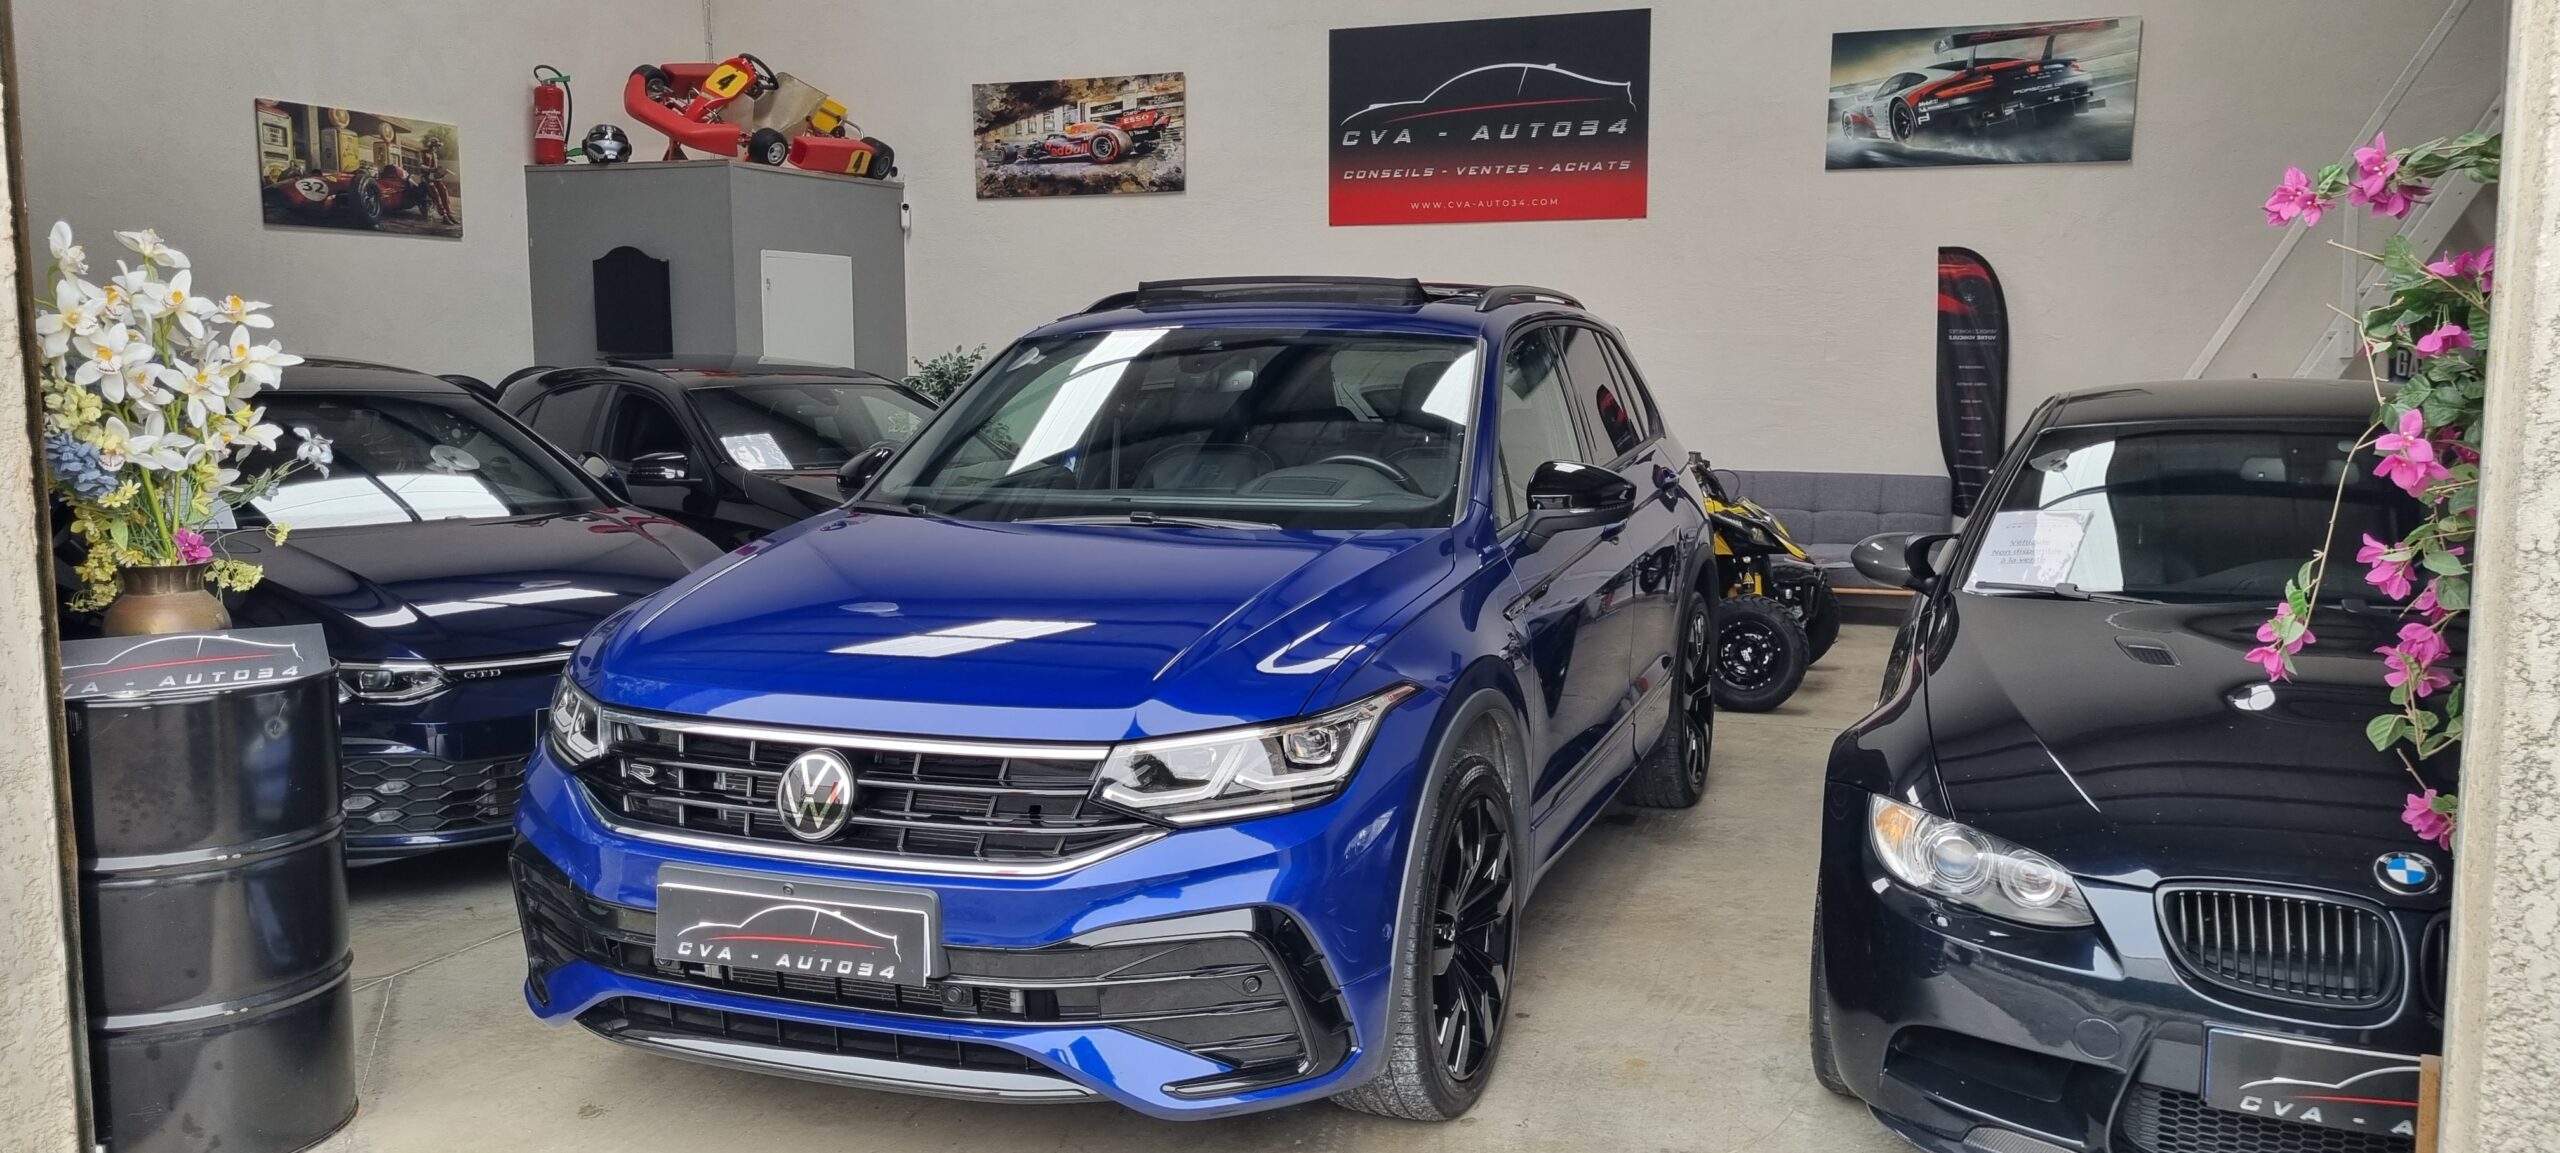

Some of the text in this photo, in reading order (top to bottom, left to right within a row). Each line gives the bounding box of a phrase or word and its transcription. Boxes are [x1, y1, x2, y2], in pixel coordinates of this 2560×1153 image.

[716, 73, 738, 91] 4
[1342, 129, 1411, 146] CVA
[1471, 119, 1628, 140] AUTO34
[852, 152, 865, 172] 4
[1343, 168, 1434, 179] CONSEILS
[1456, 164, 1530, 175] VENTES
[1550, 160, 1632, 172] ACHATS
[301, 181, 326, 194] 32
[1410, 198, 1558, 209] WWW.CVA-AUTO34.COM
[158, 665, 299, 687] AUTO34
[464, 669, 502, 679] GTD
[677, 942, 732, 960] CVA
[776, 953, 895, 980] AUTO34
[2239, 1096, 2323, 1123] CVA
